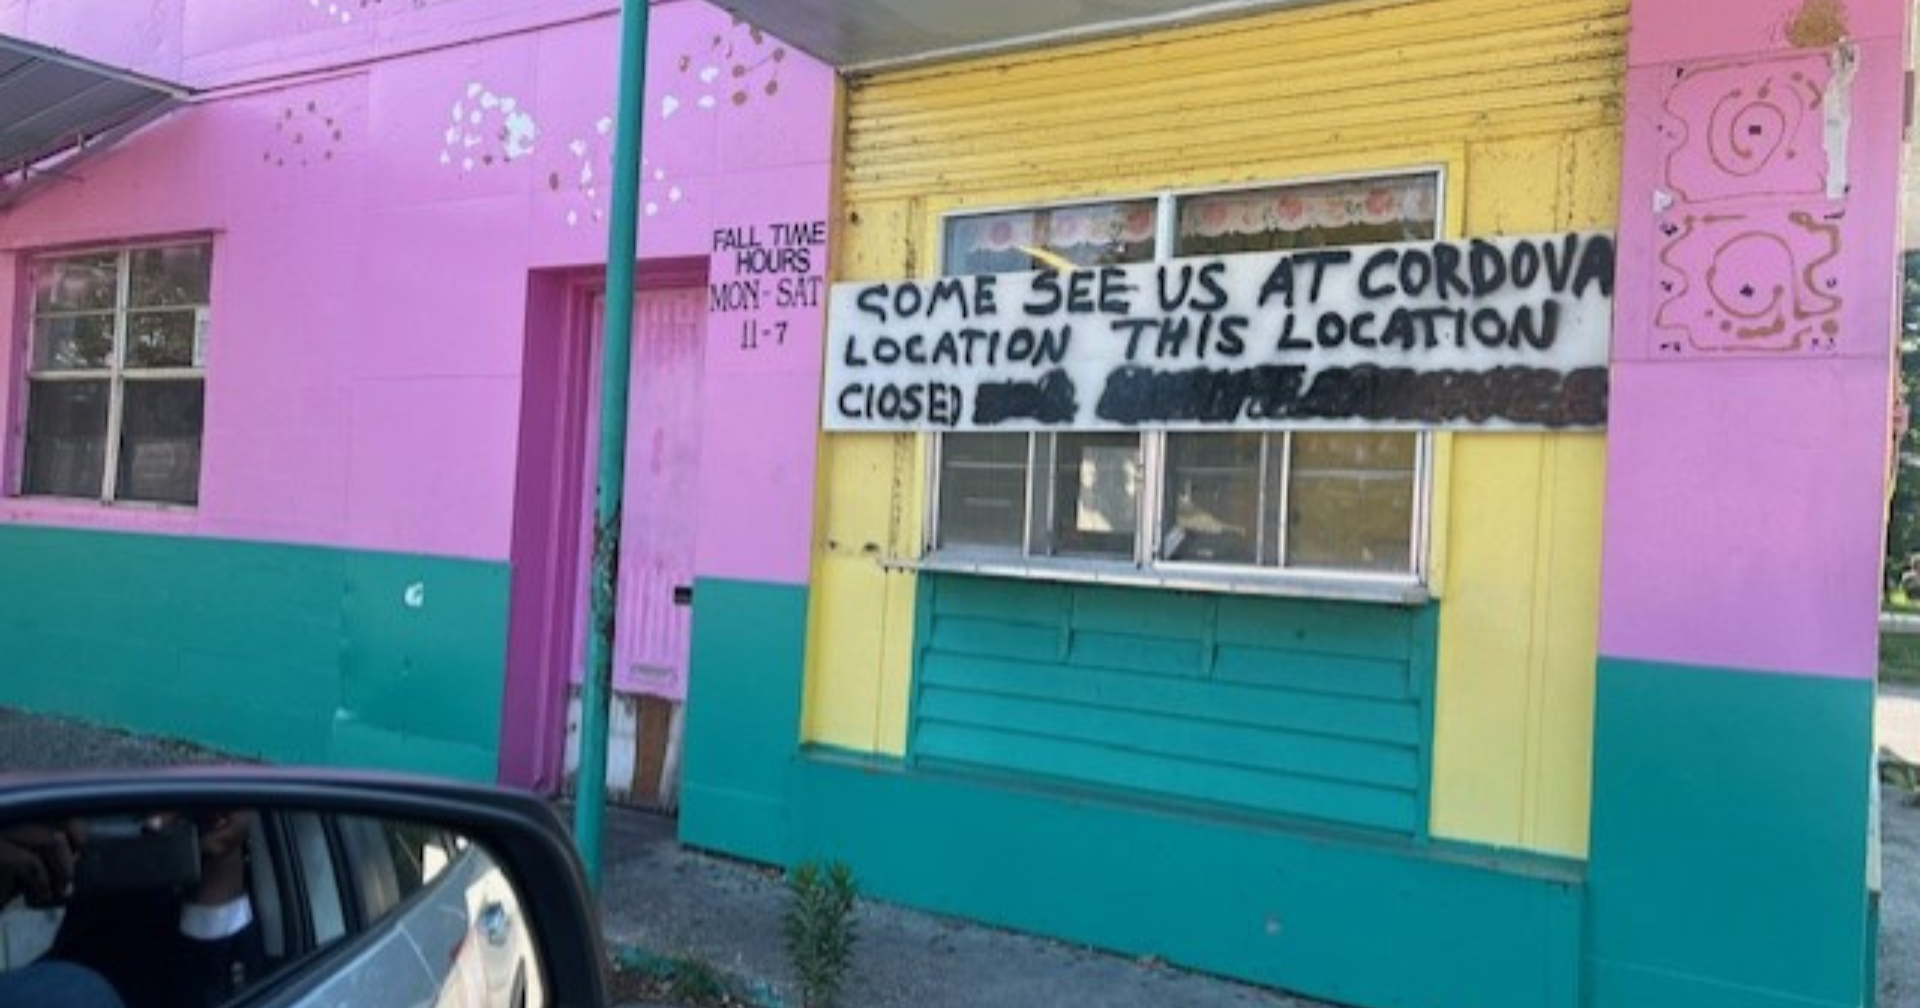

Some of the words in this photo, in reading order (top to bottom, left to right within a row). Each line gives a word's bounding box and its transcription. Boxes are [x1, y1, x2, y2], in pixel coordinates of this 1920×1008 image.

[713, 226, 762, 251] FALL
[769, 220, 826, 247] TIME
[736, 248, 811, 275] HOURS
[1024, 267, 1133, 314] SEE
[1157, 262, 1229, 311] US
[1258, 250, 1352, 307] AT
[1358, 233, 1614, 301] CORDOVA
[845, 324, 1073, 367] LOCATION
[1111, 312, 1249, 361] THIS
[1276, 300, 1560, 352] LOCATION
